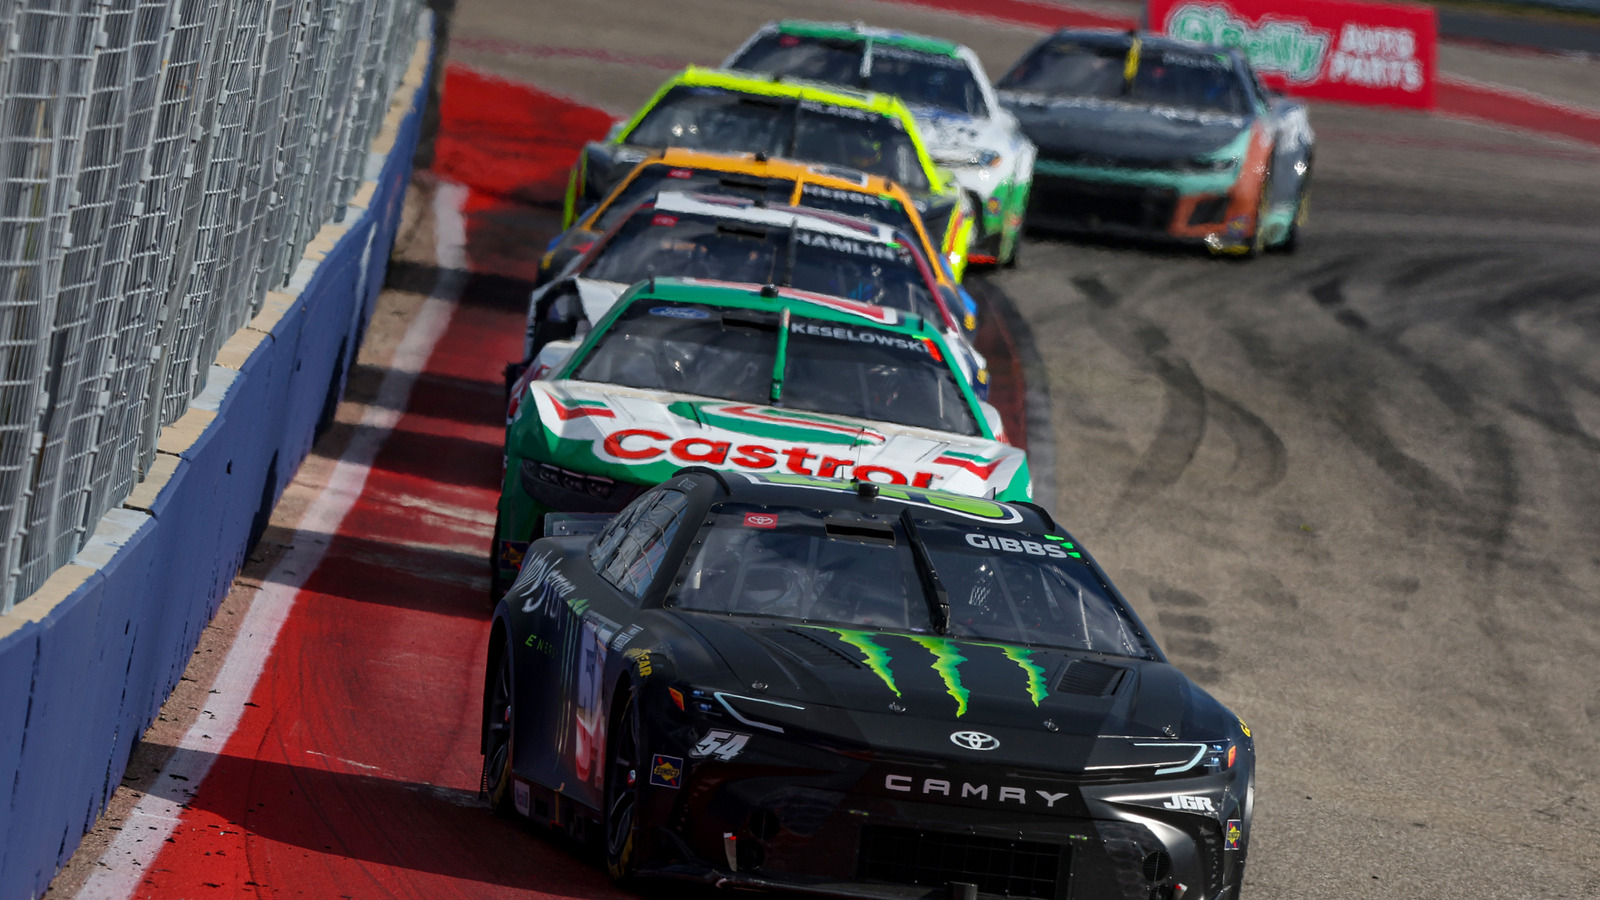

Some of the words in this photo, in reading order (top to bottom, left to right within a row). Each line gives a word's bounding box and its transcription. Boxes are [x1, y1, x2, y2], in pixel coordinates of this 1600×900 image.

[1341, 23, 1416, 58] AUTO
[1330, 52, 1424, 92] PARTS
[794, 233, 896, 262] HAMLIN
[790, 322, 930, 353] KESELOWSKI
[965, 533, 1068, 559] GIBBS
[689, 728, 753, 762] 54
[654, 765, 680, 778] SUNOCO
[885, 774, 1069, 807] CAMRY
[1163, 795, 1215, 813] JGR
